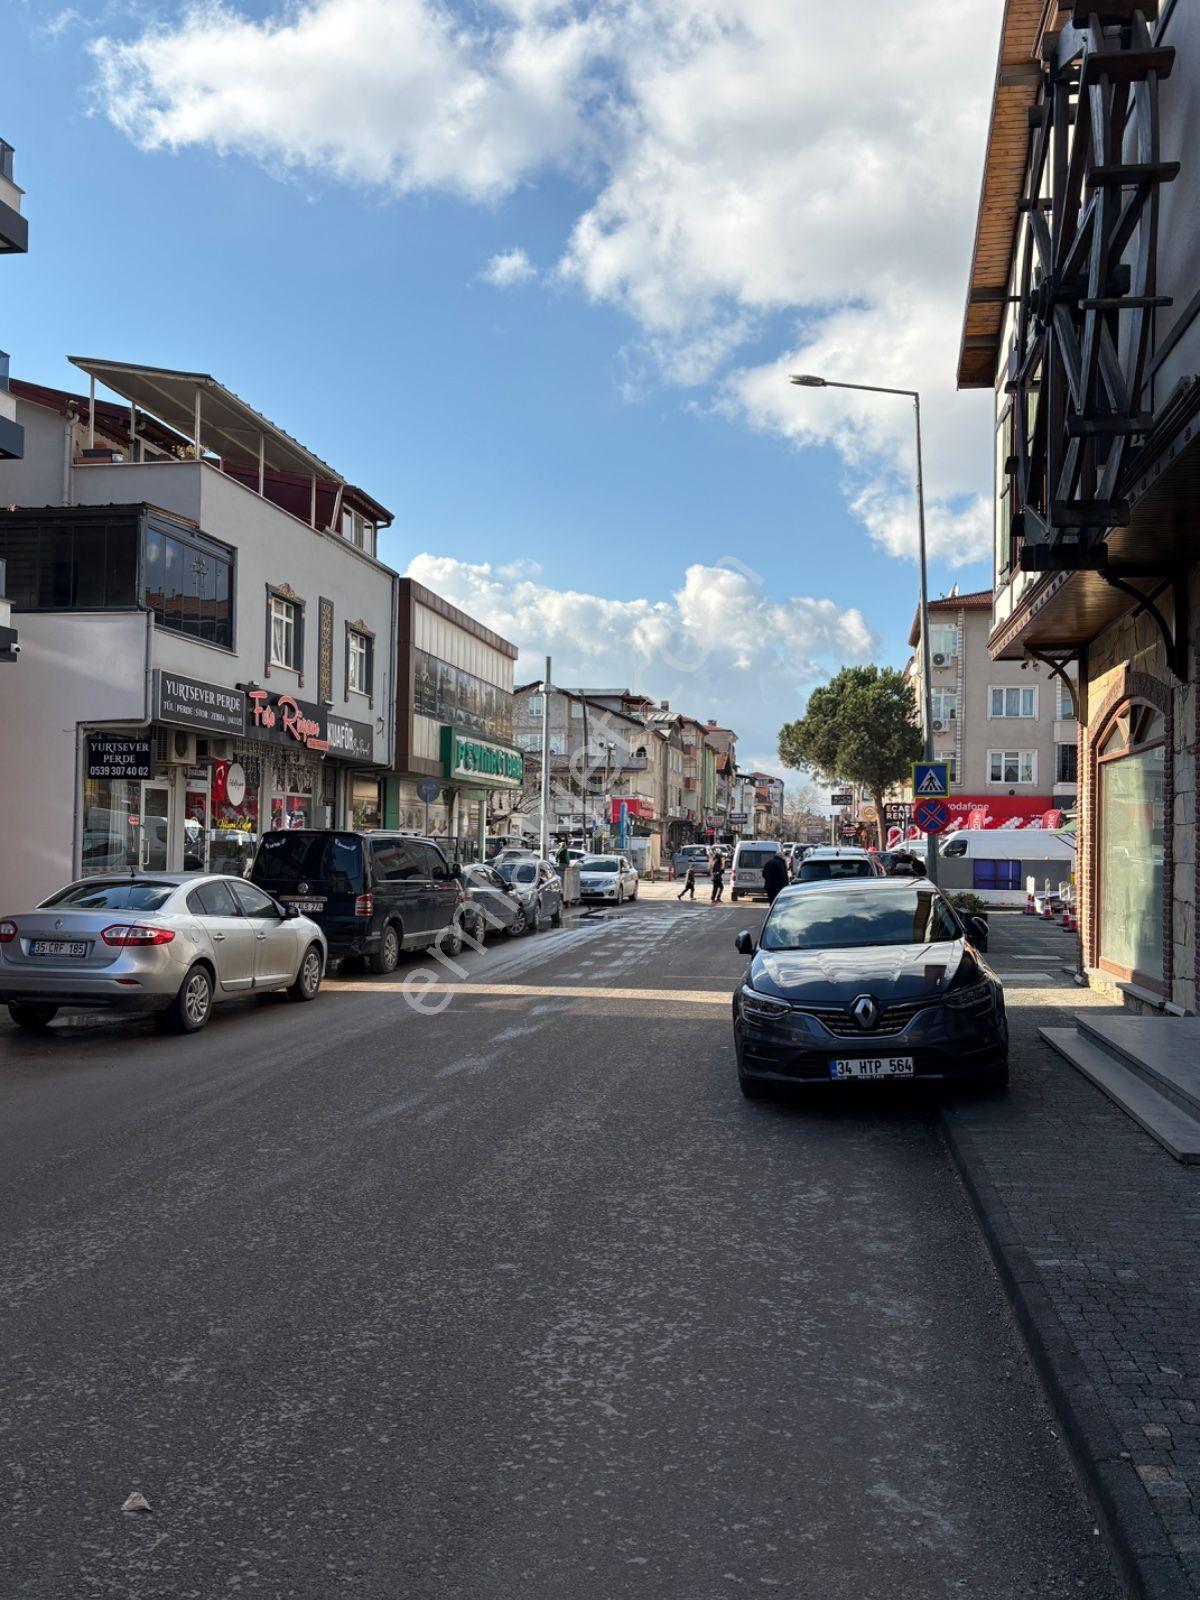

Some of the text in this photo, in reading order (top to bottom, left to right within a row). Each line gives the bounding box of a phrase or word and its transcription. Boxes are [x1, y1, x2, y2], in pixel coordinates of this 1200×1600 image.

[166, 680, 241, 712] YURTSEVER PERDE
[176, 704, 193, 715] PERDE
[91, 742, 150, 753] YURTSEVER
[103, 754, 136, 765] PERDE
[90, 766, 149, 776] 0539 307 40 02
[35, 942, 46, 952] 35
[48, 943, 65, 953] CRF
[837, 1059, 912, 1074] 34 HTP 564
